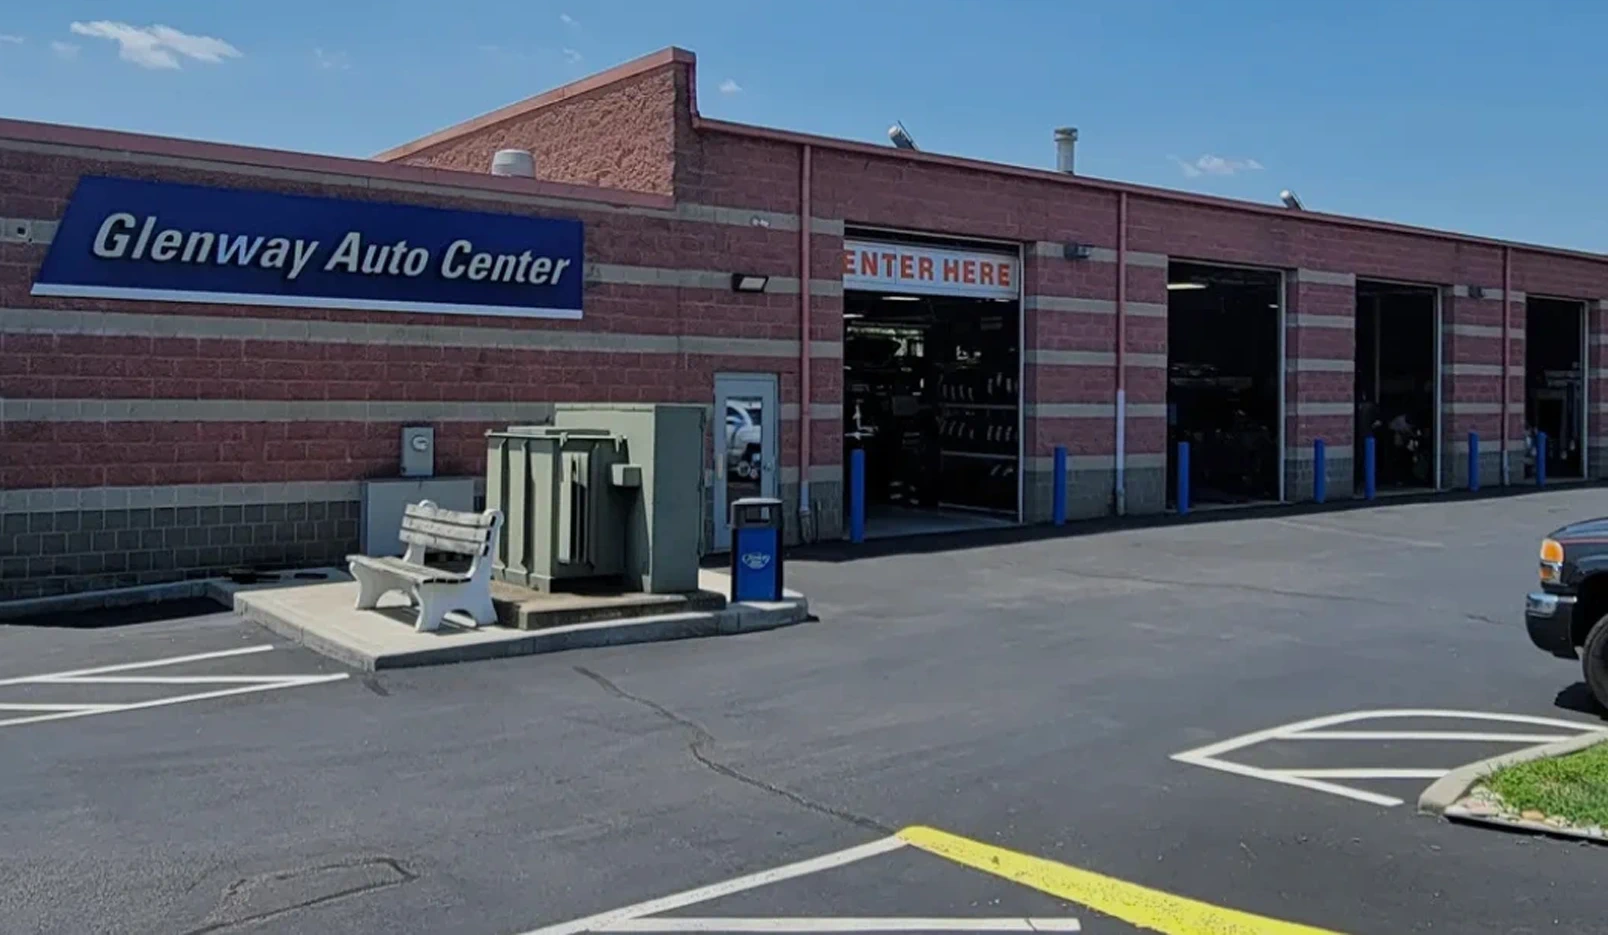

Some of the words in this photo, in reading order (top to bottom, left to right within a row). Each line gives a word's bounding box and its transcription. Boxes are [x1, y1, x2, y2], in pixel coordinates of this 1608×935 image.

[92, 211, 319, 279] Glenway
[324, 231, 429, 276] Auto
[440, 238, 570, 286] Center
[842, 250, 934, 281] ENTER
[943, 258, 1011, 287] HERE
